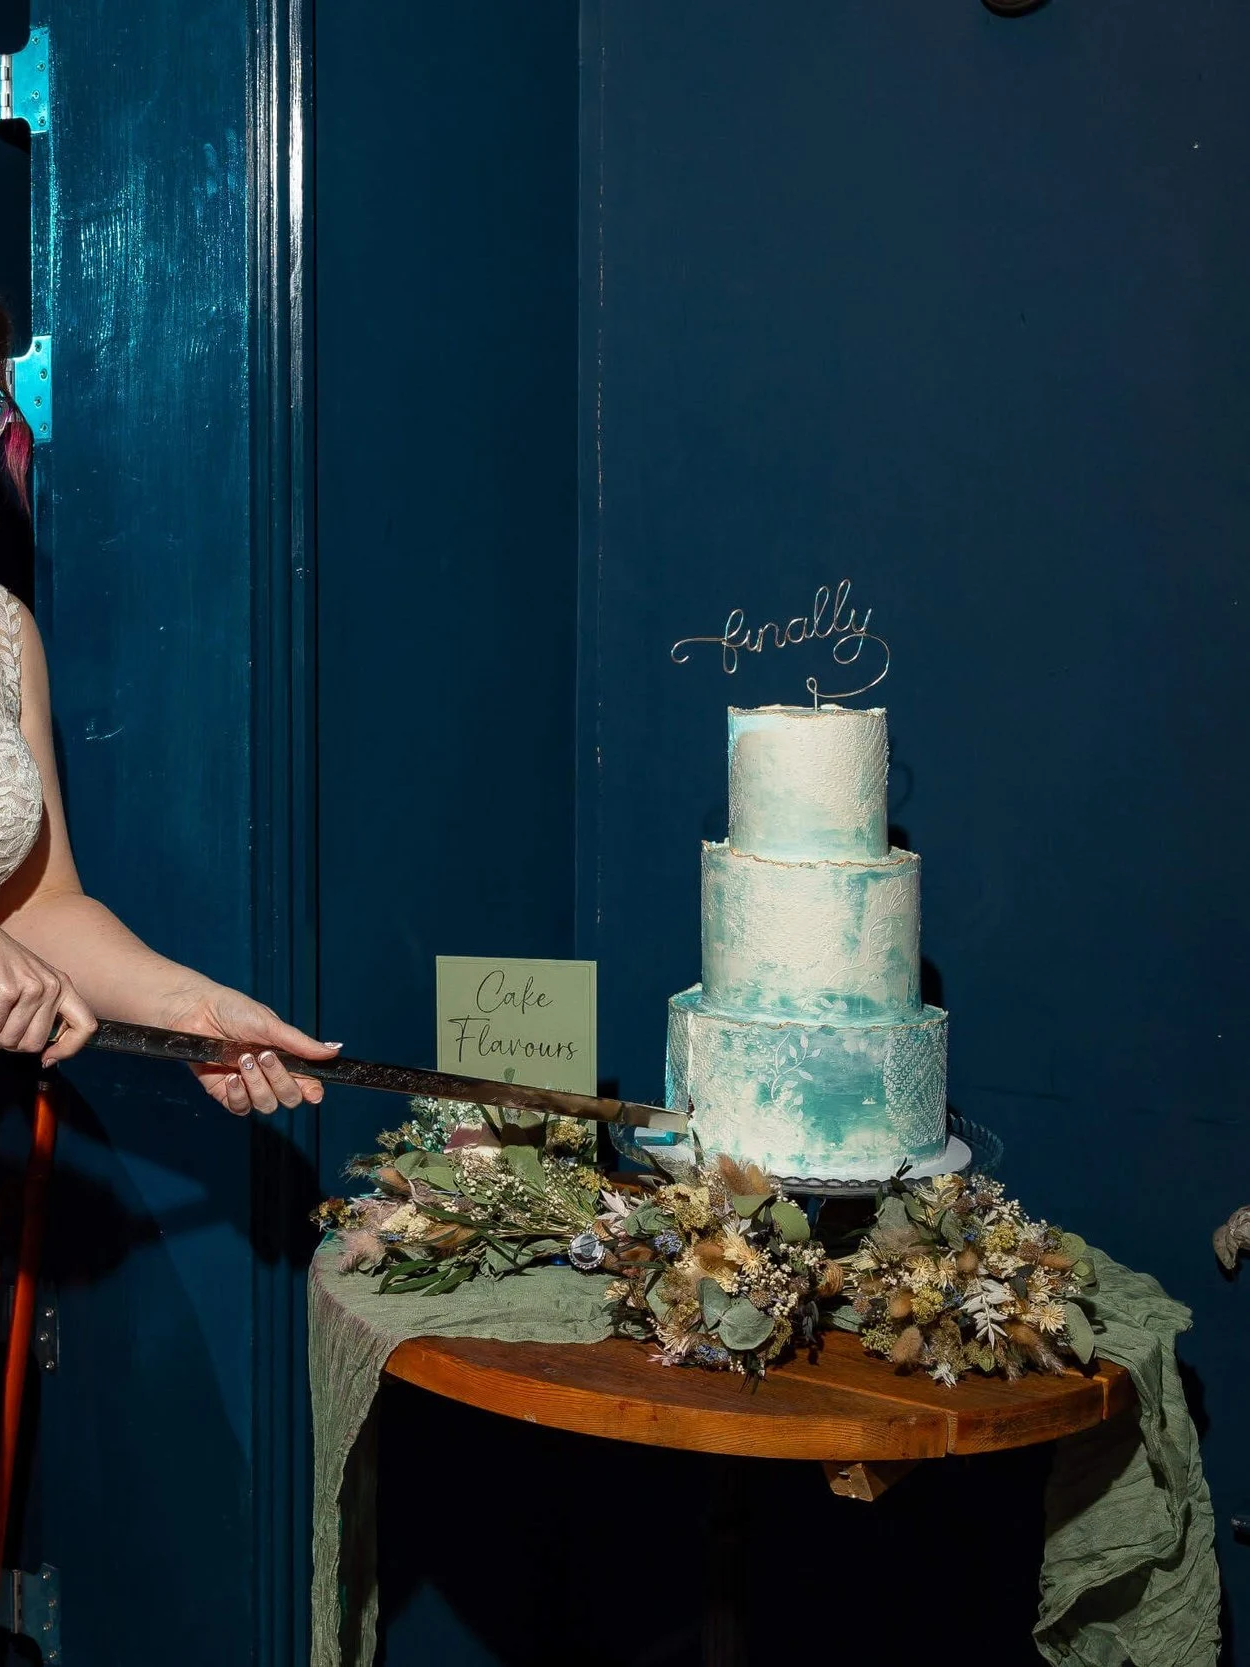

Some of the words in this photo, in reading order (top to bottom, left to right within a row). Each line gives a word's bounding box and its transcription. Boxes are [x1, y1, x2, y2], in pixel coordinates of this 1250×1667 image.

[671, 578, 890, 676] finally
[476, 970, 553, 1014] Cake
[447, 1015, 579, 1063] Flavours
